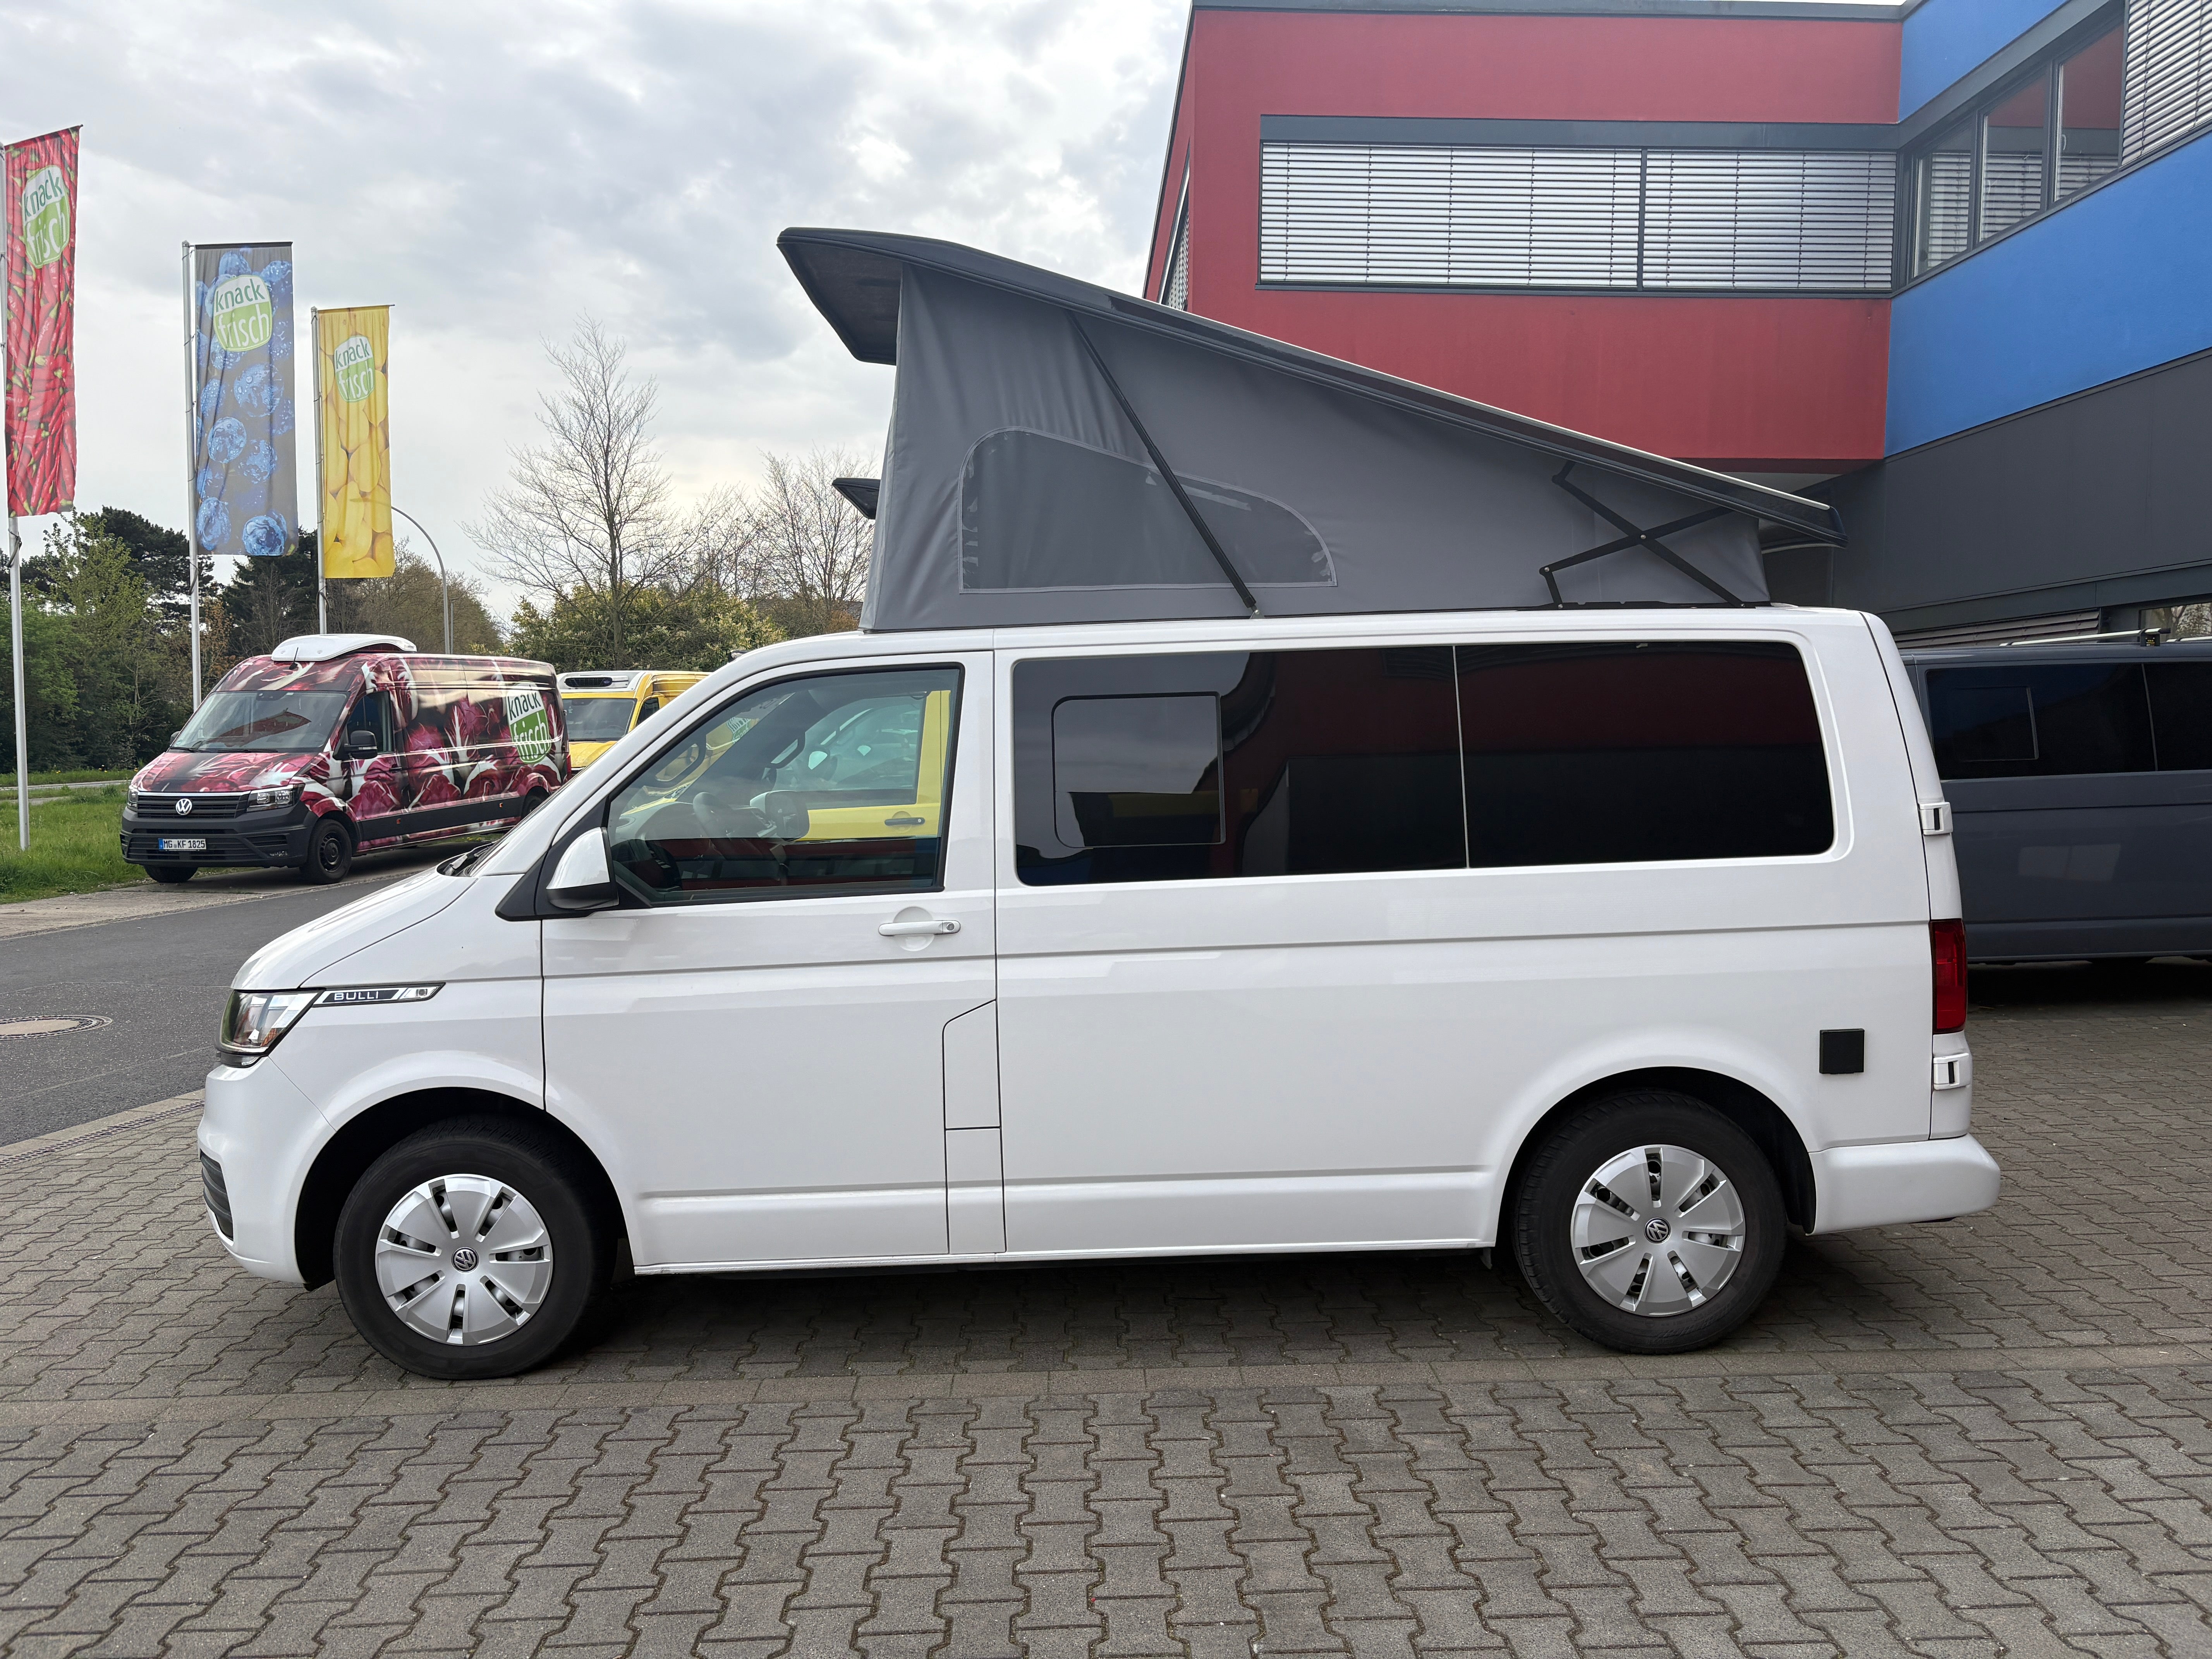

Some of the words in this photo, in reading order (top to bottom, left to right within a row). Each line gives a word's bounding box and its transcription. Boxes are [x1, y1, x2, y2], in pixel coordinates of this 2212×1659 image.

[24, 170, 62, 222] knack
[26, 201, 67, 264] frisch
[216, 278, 265, 312] knack
[218, 304, 269, 347] frisch
[336, 338, 370, 369] knack
[338, 360, 374, 400] frisch
[507, 688, 541, 721] knack
[514, 712, 550, 760] frisch
[163, 840, 173, 848] MG
[177, 840, 186, 848] KF
[188, 840, 205, 848] 1825
[334, 991, 379, 1001] BULLI
